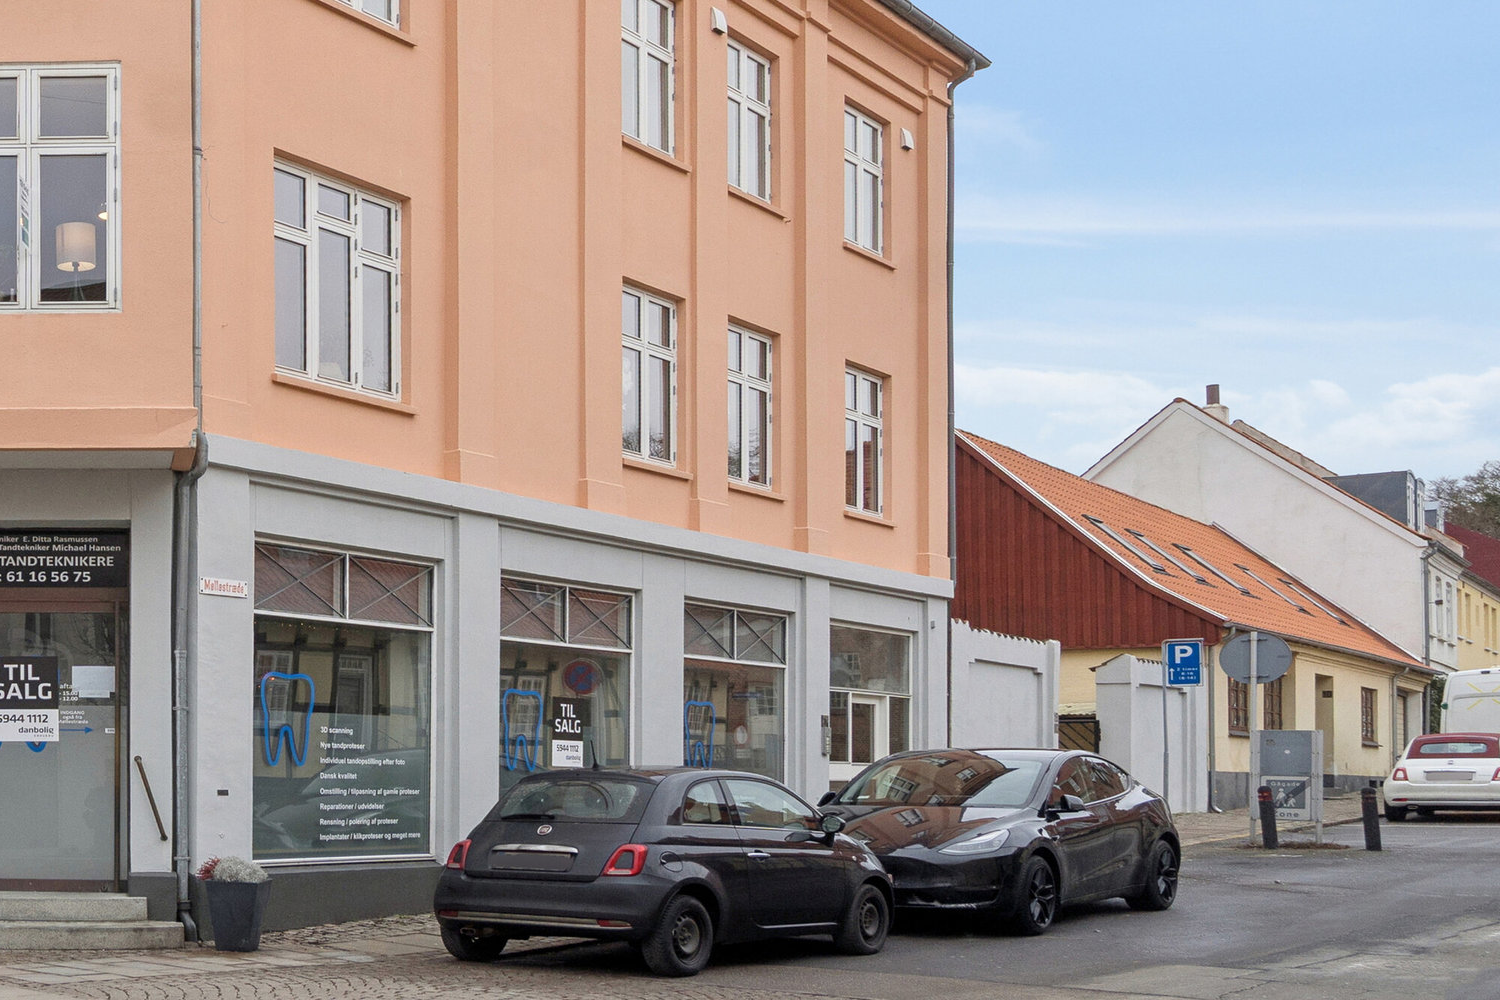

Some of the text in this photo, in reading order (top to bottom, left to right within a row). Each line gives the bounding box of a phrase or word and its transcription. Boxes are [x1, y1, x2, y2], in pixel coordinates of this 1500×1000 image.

[33, 535, 51, 543] Ditta
[0, 556, 114, 567] TANDTEKNIKERE
[6, 571, 24, 582] 61
[29, 571, 46, 582] 16
[51, 571, 68, 582] 56
[73, 571, 91, 582] 75
[204, 579, 244, 594] Møllestræde
[1175, 645, 1193, 664] P
[4, 664, 40, 681] TIL
[560, 704, 576, 718] TIL
[27, 714, 48, 723] 1112
[18, 726, 54, 735] danbolig
[555, 719, 581, 733] SALG
[329, 727, 353, 735] scanning
[320, 742, 330, 750] Nye
[347, 758, 381, 766] tandopstilling
[320, 788, 347, 796] Omstilling
[351, 788, 376, 796] tilpasning
[383, 788, 398, 796] gamle
[320, 803, 353, 811] Reparationer
[320, 818, 345, 826] Rensning
[349, 818, 370, 826] polering
[354, 832, 384, 841] klikproteser
